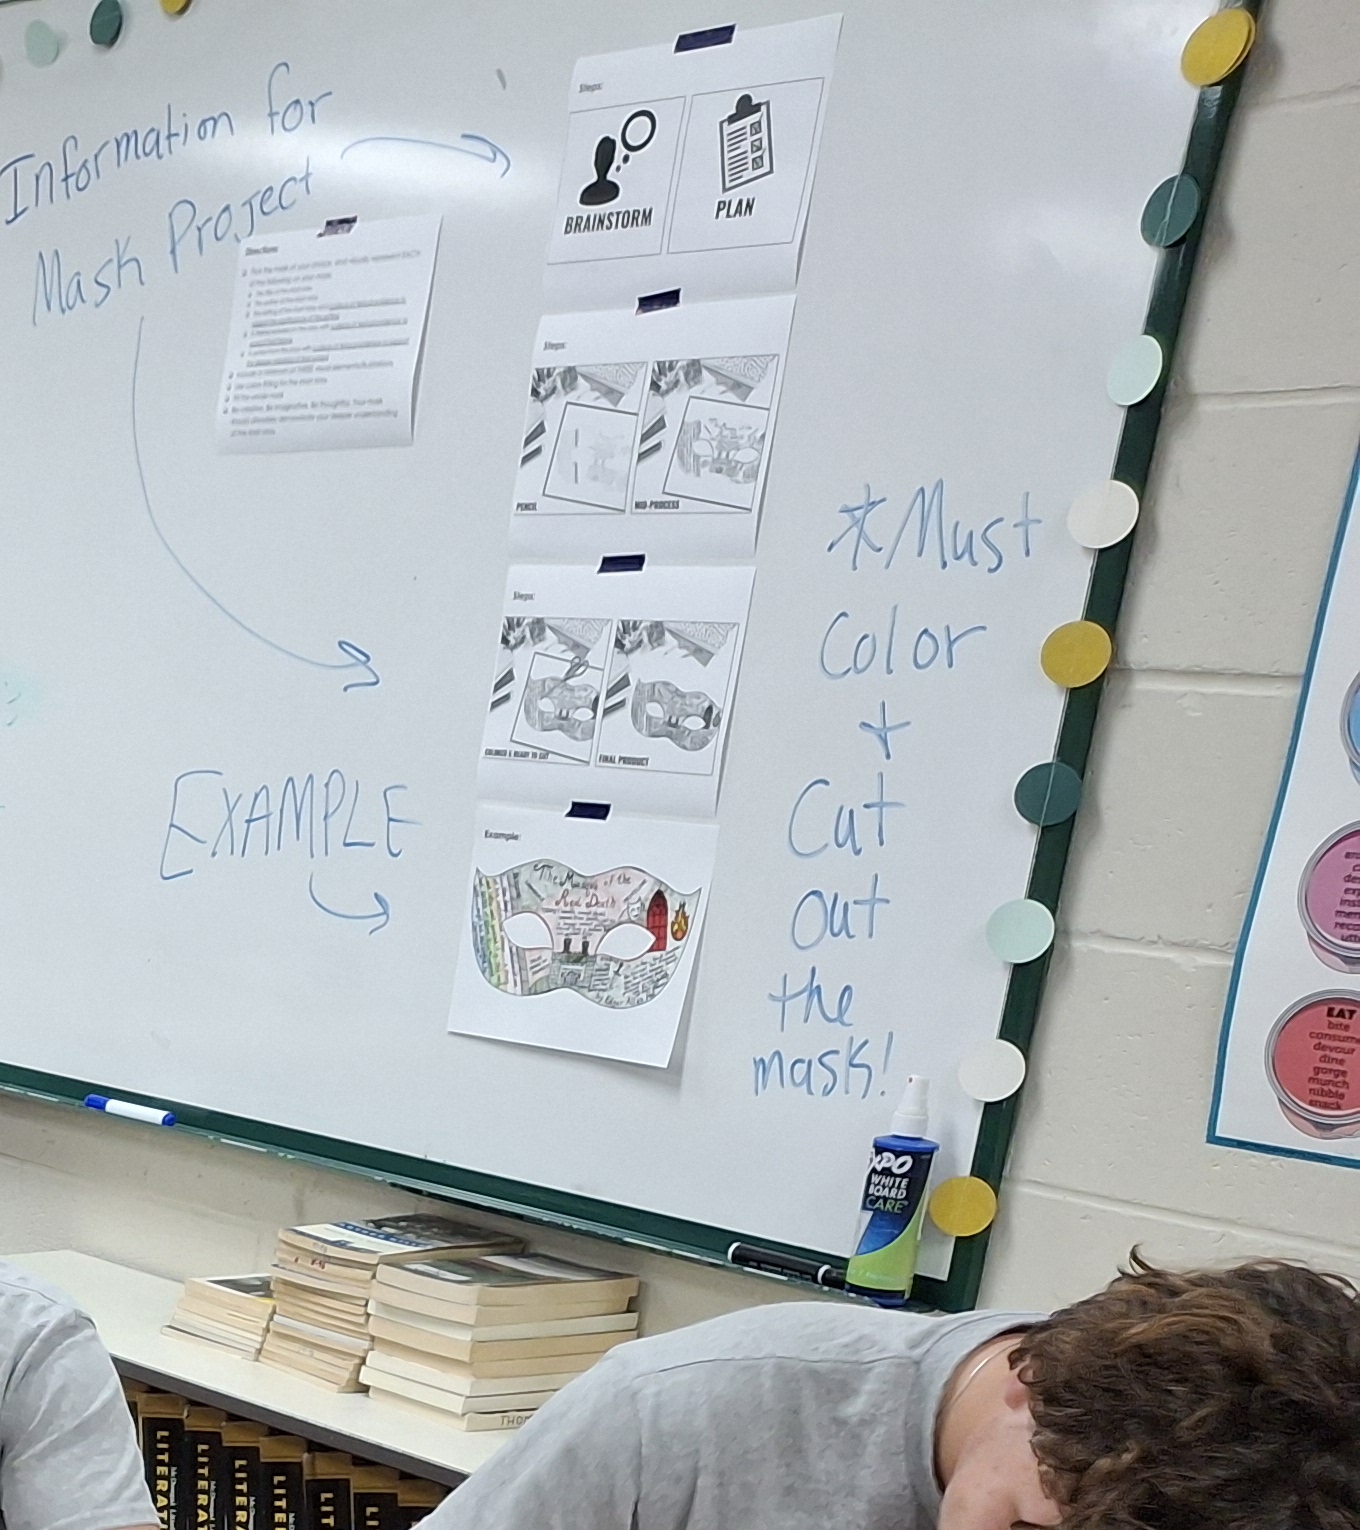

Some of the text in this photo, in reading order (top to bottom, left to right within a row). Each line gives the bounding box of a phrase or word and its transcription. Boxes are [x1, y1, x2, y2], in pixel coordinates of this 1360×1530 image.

[0, 63, 333, 225] Information for
[714, 197, 756, 220] PLAN
[563, 207, 654, 236] BRAINSTORM
[33, 235, 145, 327] Mask
[168, 156, 313, 274] Project
[820, 603, 988, 680] Color
[159, 768, 423, 882] EXAMPLE
[767, 965, 855, 1033] the
[1326, 1006, 1357, 1020] EAT
[1313, 1041, 1356, 1055] devour
[753, 1031, 894, 1101] mask!
[1318, 1054, 1346, 1067] dine
[1313, 1066, 1348, 1079] gorge
[868, 1185, 907, 1200] BOARD
[870, 1173, 910, 1189] WHITE
[866, 1198, 909, 1214] CARE
